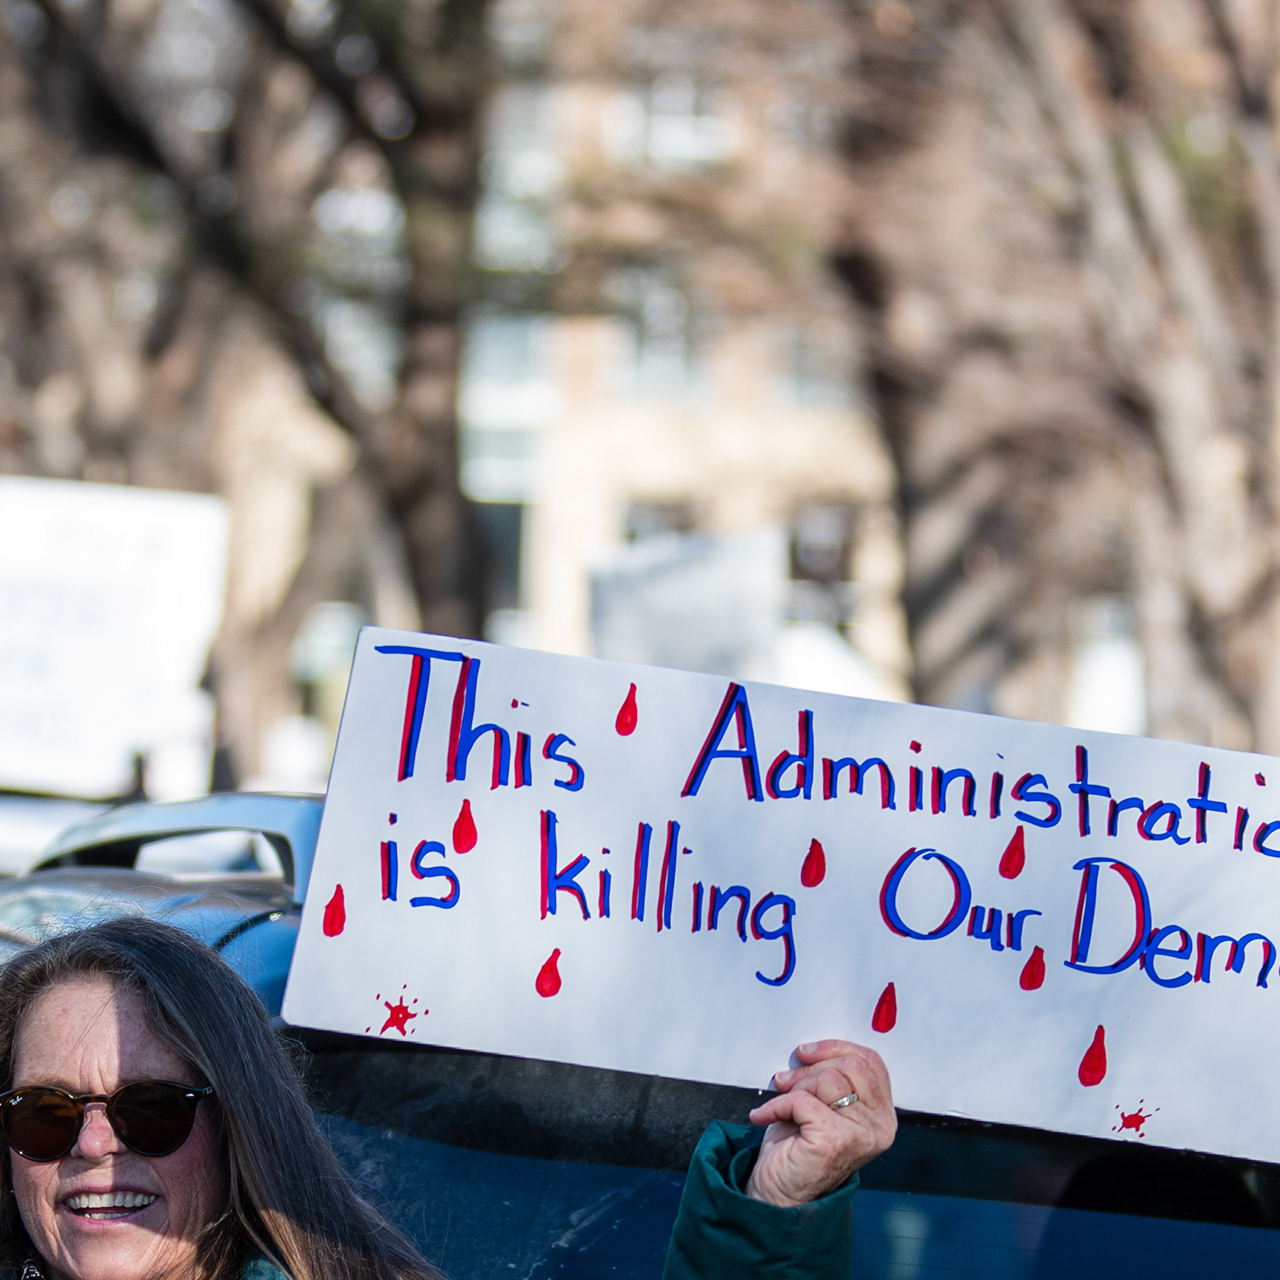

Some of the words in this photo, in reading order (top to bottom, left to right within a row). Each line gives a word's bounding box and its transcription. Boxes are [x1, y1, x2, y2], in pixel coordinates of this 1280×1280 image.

[375, 645, 584, 791] This
[380, 811, 461, 909] is
[539, 808, 797, 986] killing
[878, 847, 1043, 951] Our
